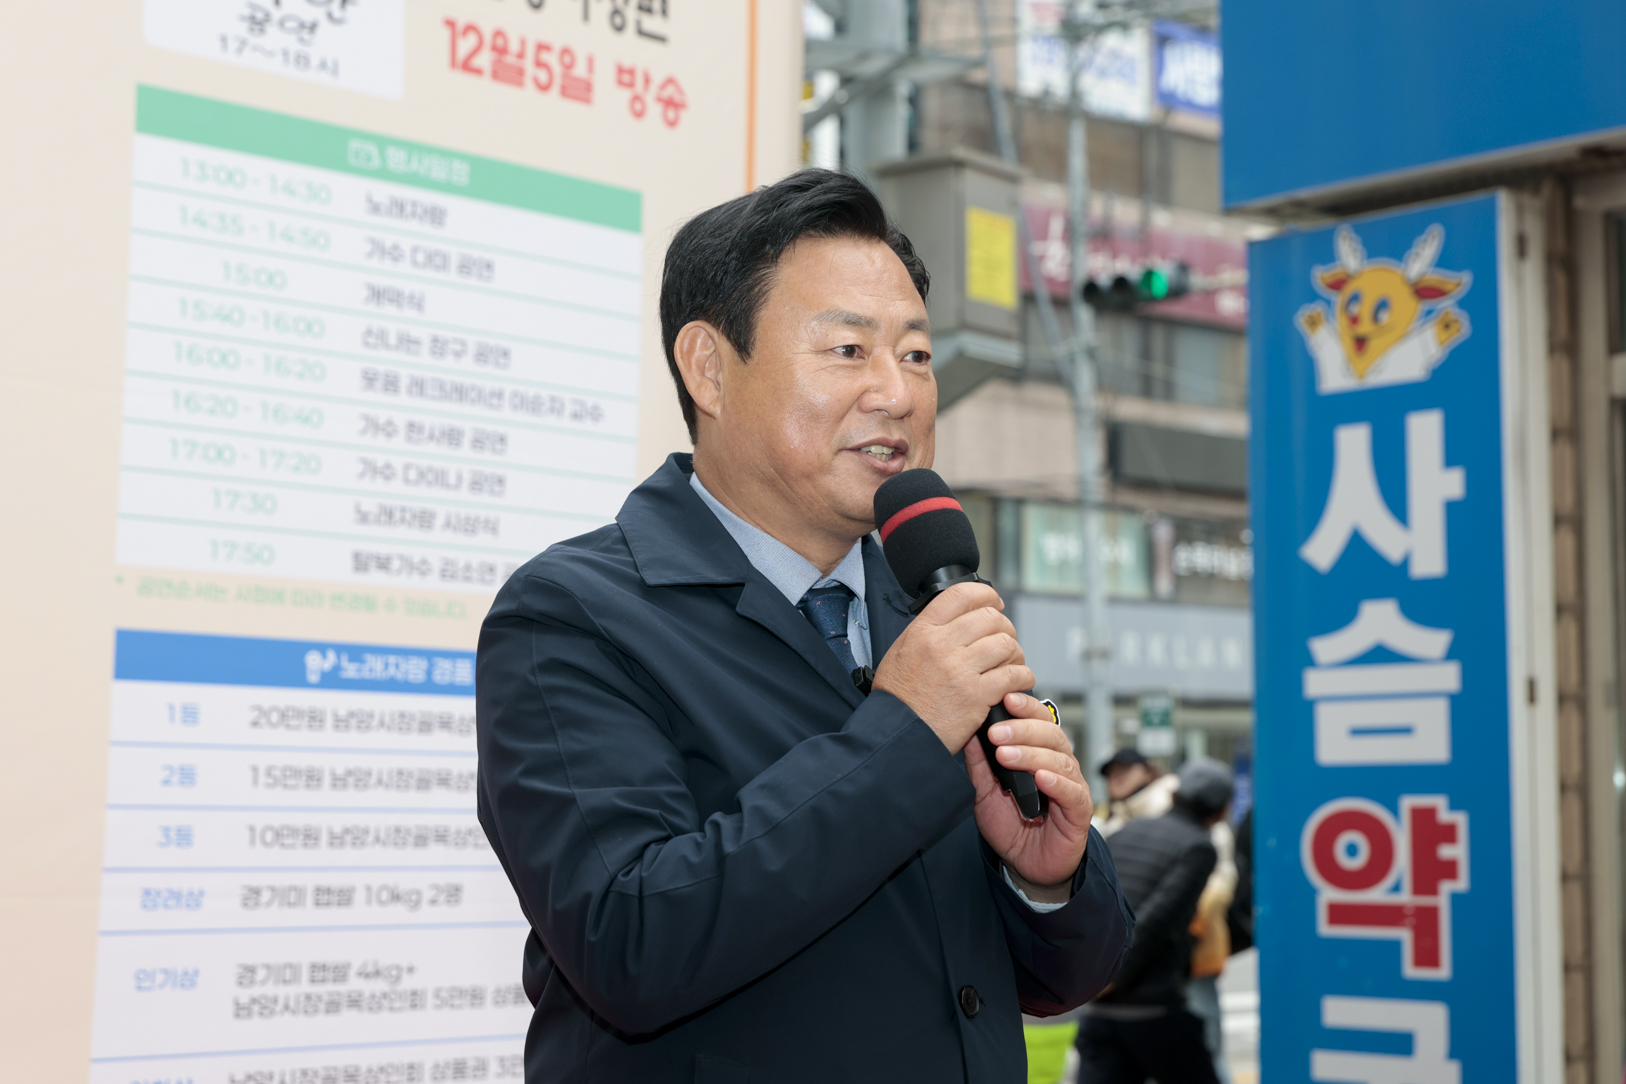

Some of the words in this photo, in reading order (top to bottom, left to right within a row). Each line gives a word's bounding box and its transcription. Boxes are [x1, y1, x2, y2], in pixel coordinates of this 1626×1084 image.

[443, 17, 594, 105] 12월5일
[615, 59, 688, 128] 방송
[384, 144, 470, 187] 행사일정
[364, 191, 448, 229] 노래자랑
[364, 235, 405, 265] 가수
[456, 250, 495, 284] 공연
[363, 281, 426, 316] 개막식
[361, 323, 423, 357] 신나는
[430, 333, 469, 362] 장구
[473, 340, 512, 371] 공연
[360, 367, 400, 396] 웃음
[405, 373, 505, 411] 레크레이션
[568, 397, 605, 425] 교수
[358, 412, 399, 440] 가수
[404, 419, 465, 450] 한사랑
[469, 426, 509, 457] 공연
[356, 455, 397, 484] 가수
[467, 468, 507, 498] 공연
[354, 501, 436, 532] 노래자랑
[440, 510, 500, 538] 시상식
[352, 549, 433, 577] 탈북가수
[339, 651, 429, 684] 노래자랑
[431, 656, 474, 687] 경품
[167, 702, 200, 727] 1등
[249, 704, 326, 732] 20만원
[160, 764, 197, 788] 2등
[249, 765, 324, 790] 15만원
[157, 825, 195, 849] 3등
[246, 824, 322, 849] 10만원
[139, 887, 205, 911] 장려상
[240, 885, 306, 911] 경기미
[363, 883, 422, 912] 10kg
[427, 882, 464, 908] 2명
[134, 967, 199, 992] 인기상
[236, 962, 302, 989] 경기미
[233, 987, 427, 1020] 남양시장골목상인회
[432, 985, 487, 1010] 5만원
[429, 1056, 490, 1083] 상품권
